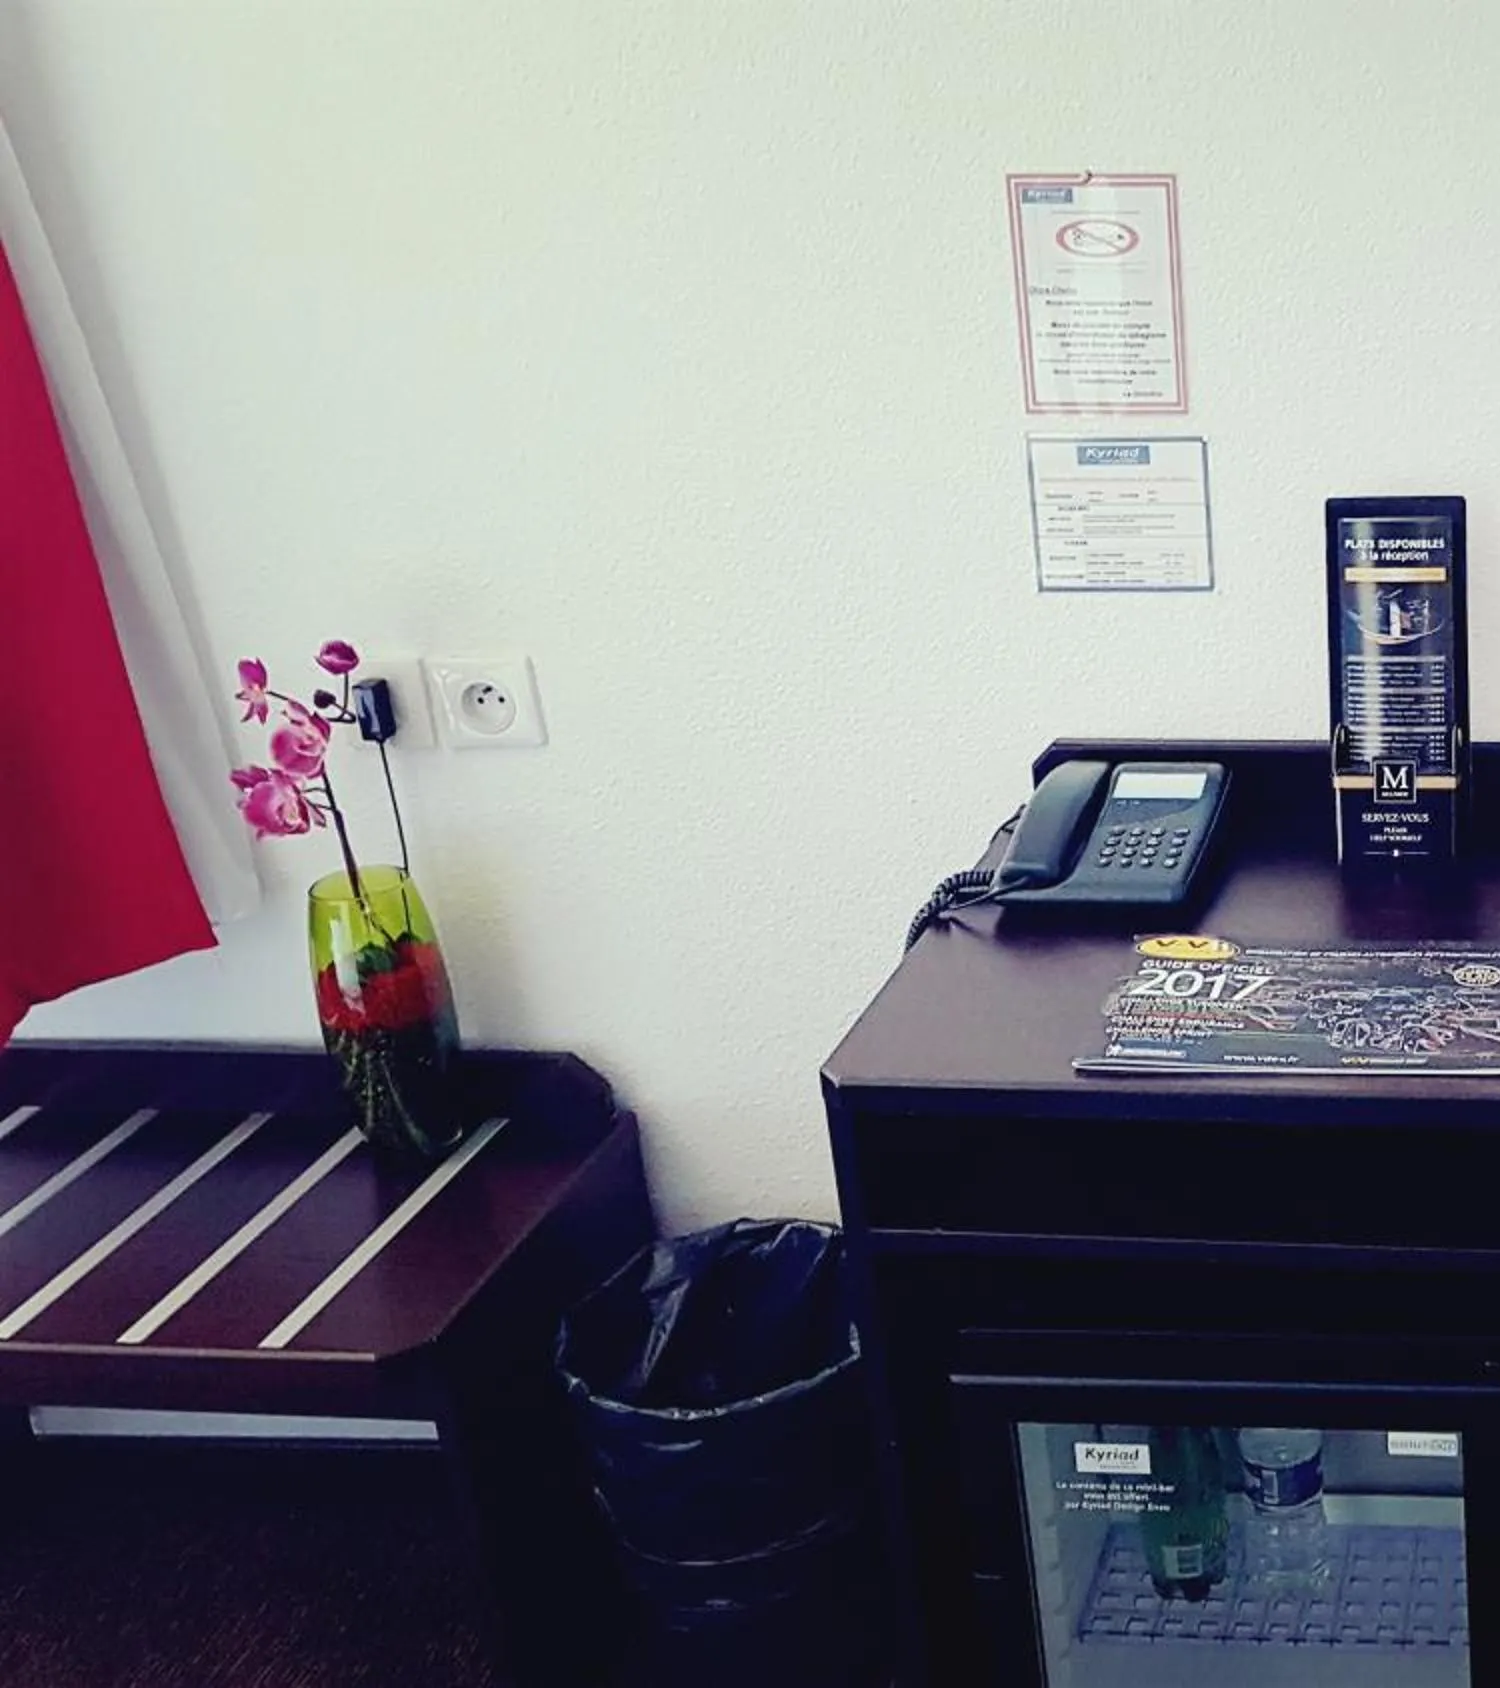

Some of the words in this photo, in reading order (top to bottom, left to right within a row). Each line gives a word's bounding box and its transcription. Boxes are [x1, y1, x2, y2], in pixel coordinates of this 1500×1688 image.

[1344, 539, 1374, 549] PLATS
[1378, 538, 1445, 549] DISPONIBLES
[1369, 551, 1379, 560] la
[1381, 551, 1428, 563] réception
[1381, 766, 1409, 789] M
[1142, 959, 1194, 969] GUIDE
[1199, 961, 1276, 975] OFFICIEL
[1128, 968, 1273, 1000] 2017
[1085, 1448, 1140, 1462] Kyriad
